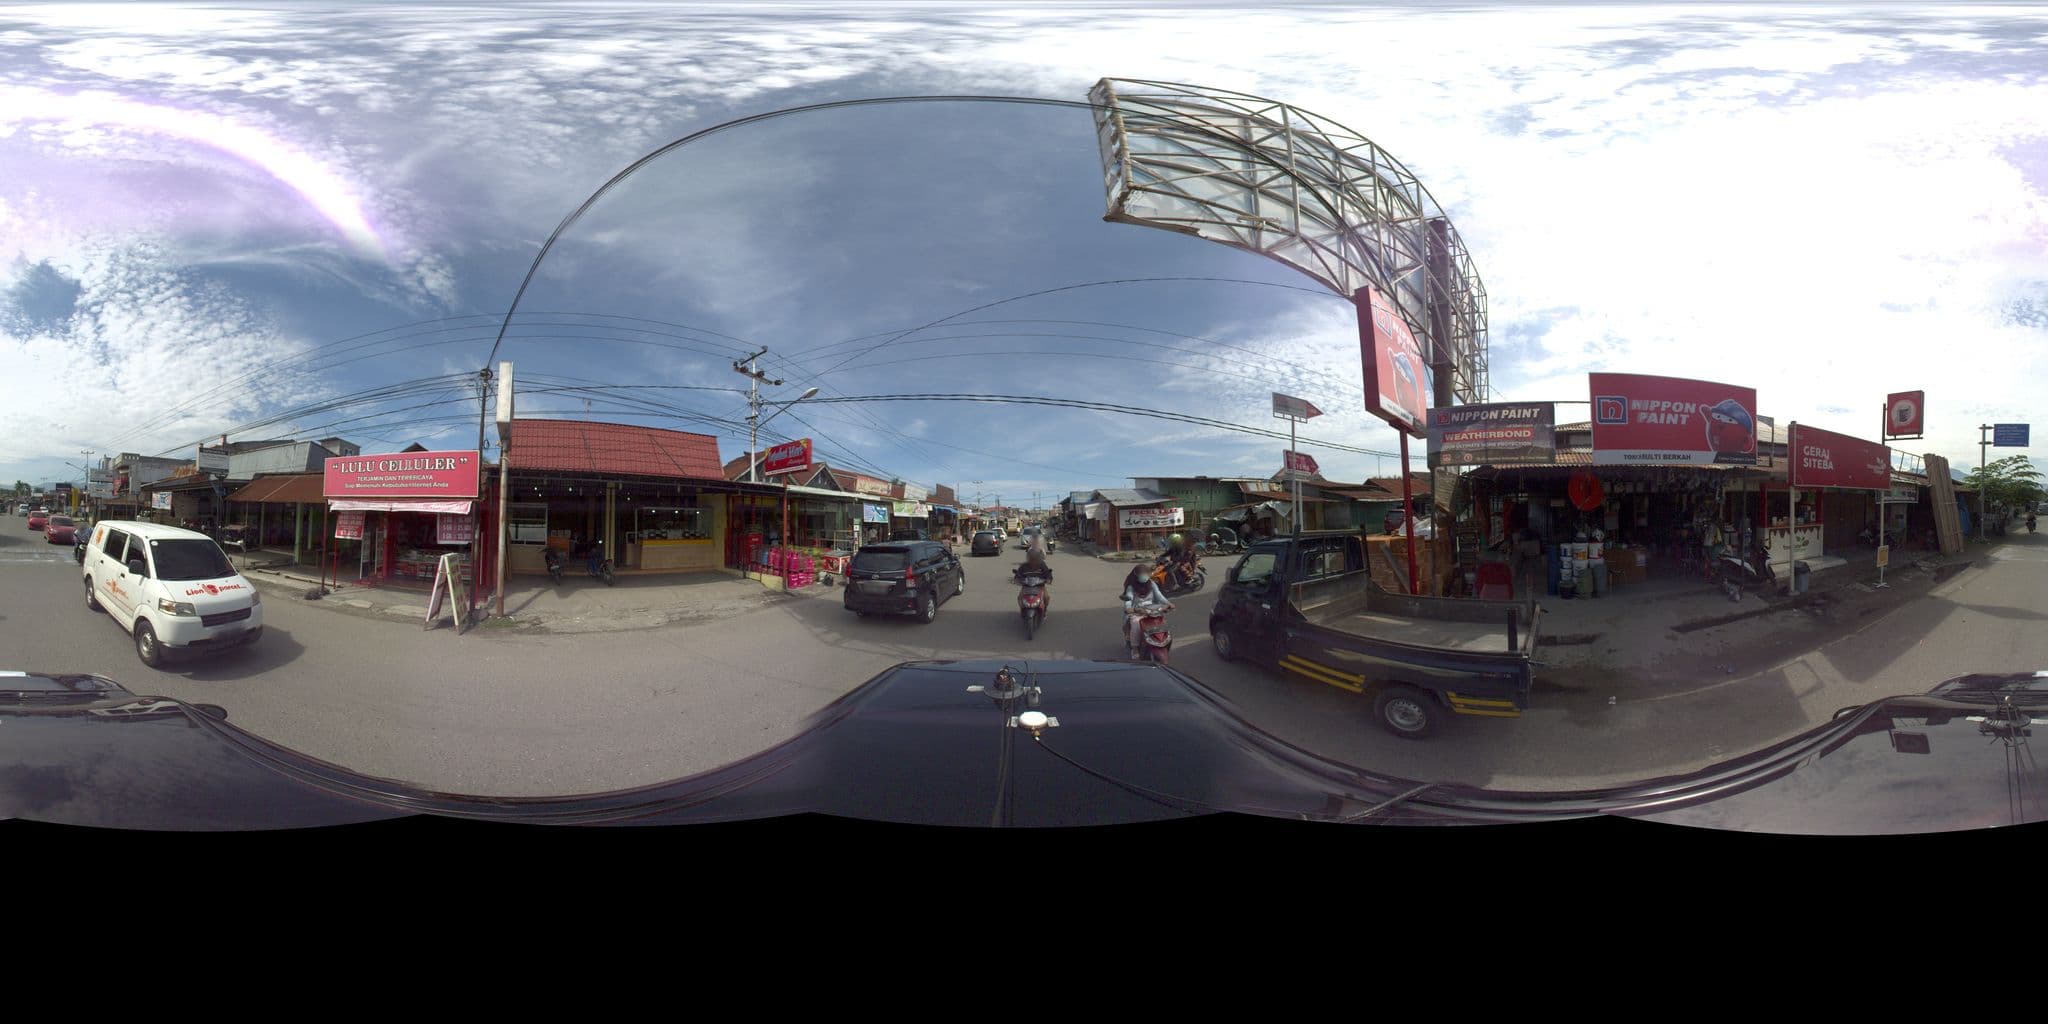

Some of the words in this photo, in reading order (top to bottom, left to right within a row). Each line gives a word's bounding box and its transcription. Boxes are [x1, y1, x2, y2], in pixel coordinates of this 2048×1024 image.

[1632, 400, 1696, 414] NIPPON
[1451, 410, 1499, 422] NIPPON
[1501, 408, 1540, 419] PAINT
[1637, 412, 1690, 425] PAINT
[1444, 429, 1532, 441] WEATHERBOND
[1803, 457, 1834, 470] SITEBA
[185, 588, 204, 596] Lion
